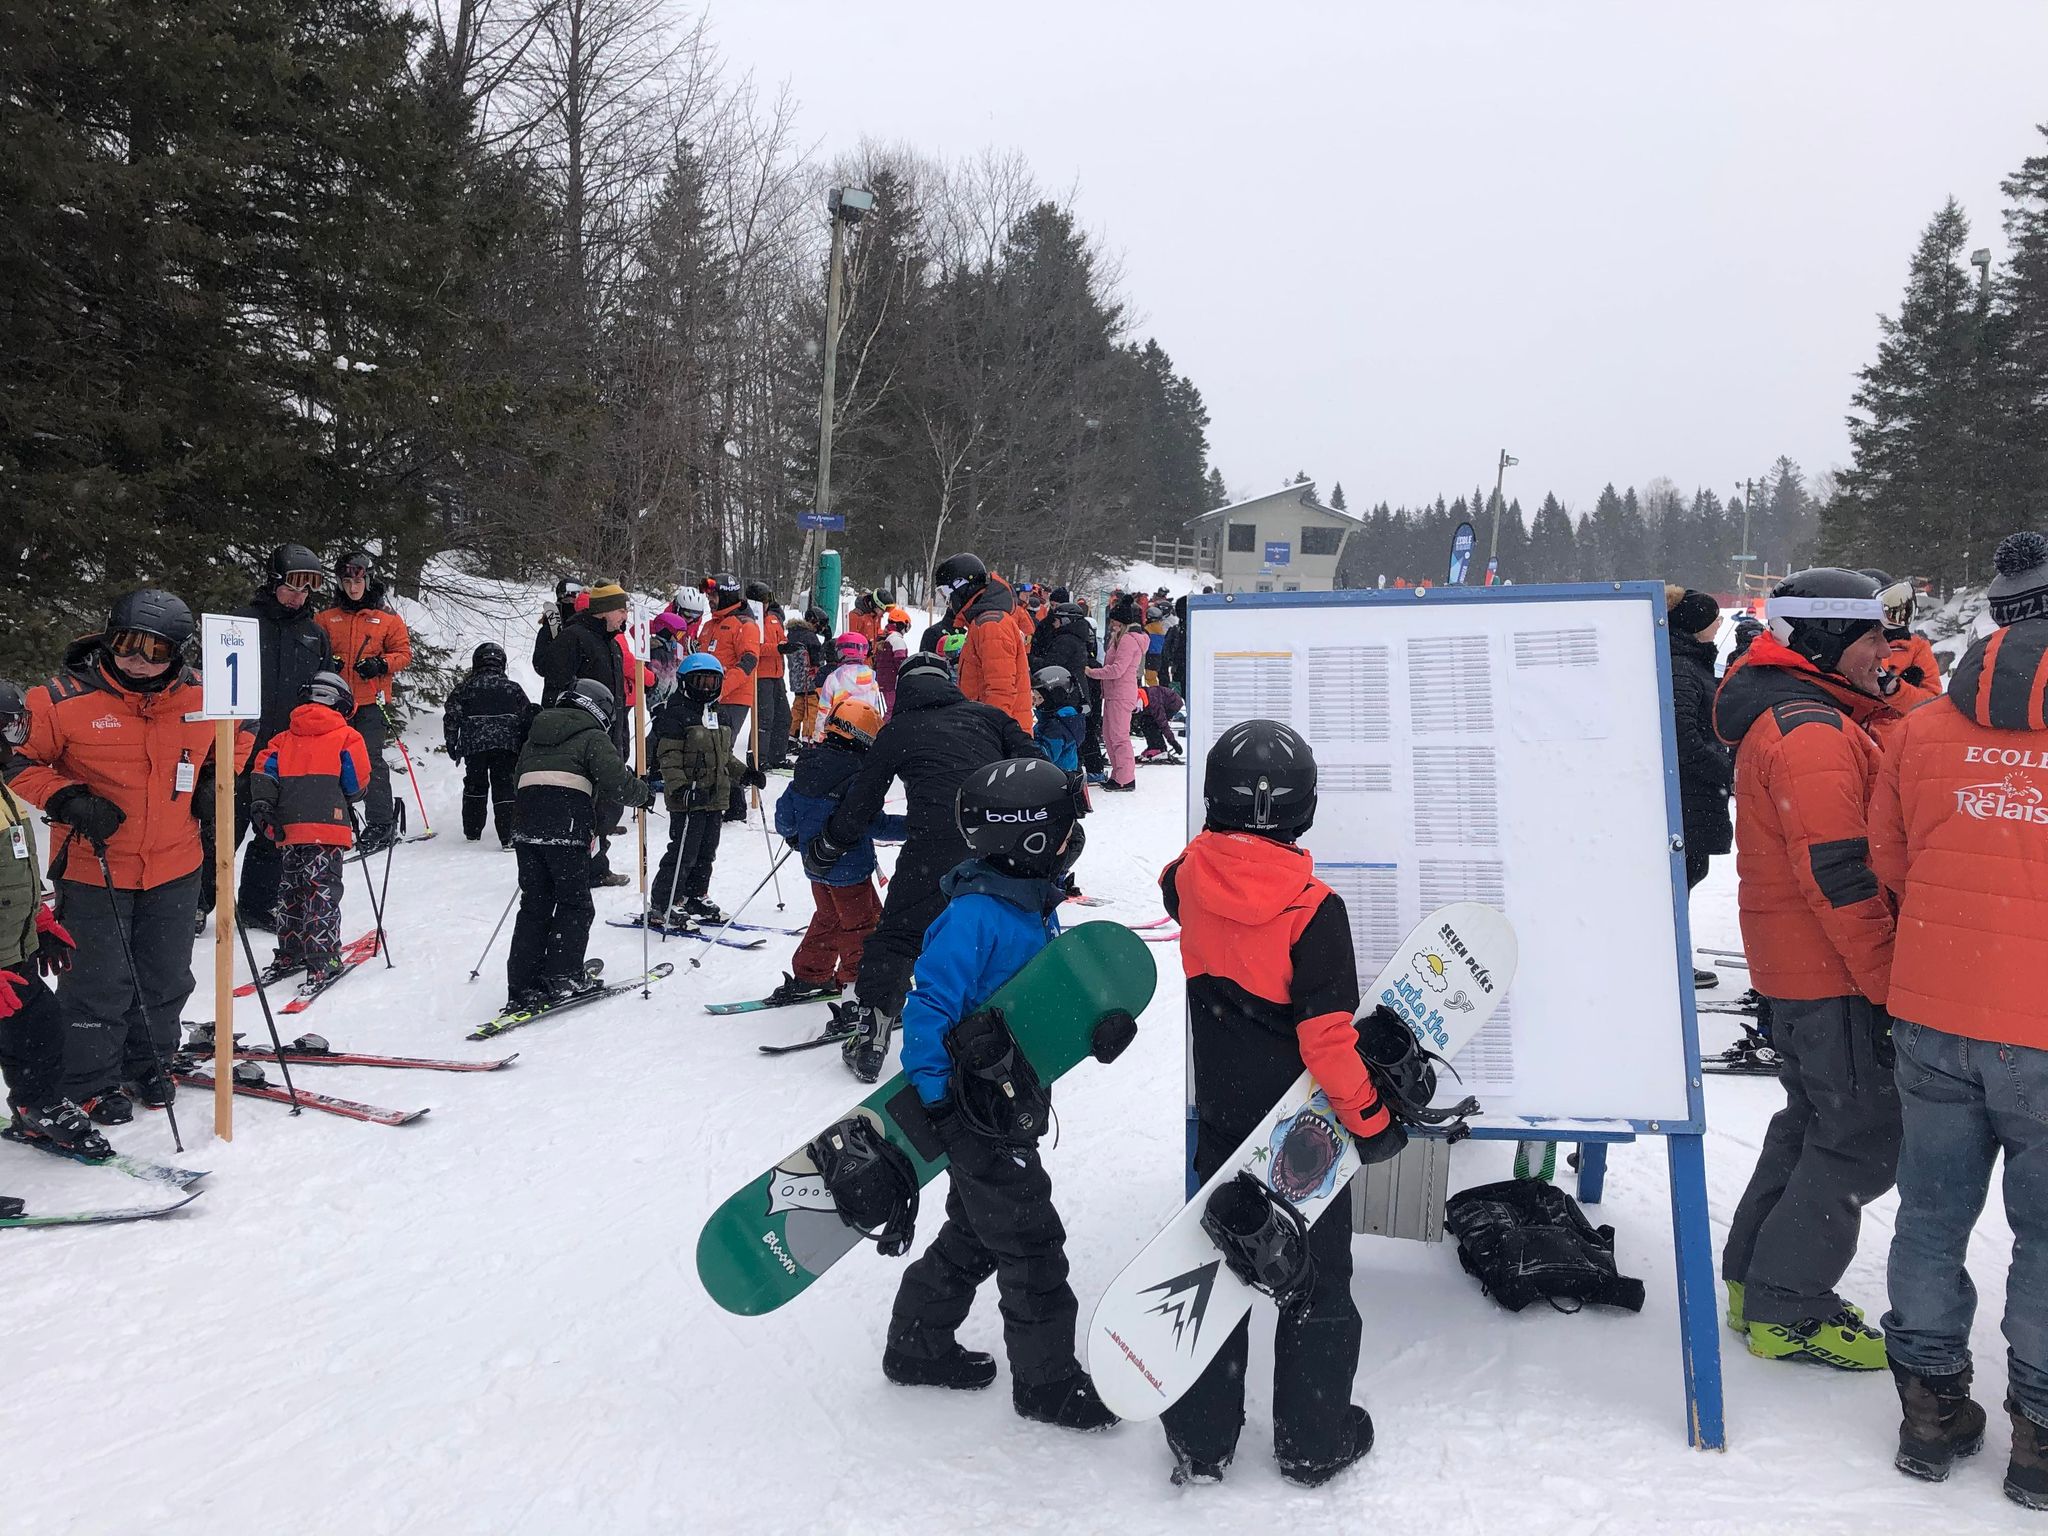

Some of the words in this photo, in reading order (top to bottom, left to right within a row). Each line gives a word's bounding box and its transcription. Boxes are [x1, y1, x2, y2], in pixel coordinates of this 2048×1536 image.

[220, 633, 245, 648] Relais
[640, 622, 646, 654] 3
[225, 651, 238, 706] 1
[1953, 791, 2048, 824] Relais
[1978, 788, 1995, 800] Le
[985, 807, 1048, 823] bollé
[1441, 923, 1468, 958] SEVEN
[1465, 957, 1494, 994] PEAKS
[1393, 973, 1427, 1020] into
[1422, 1009, 1449, 1051] the
[762, 1230, 796, 1275] Bloom
